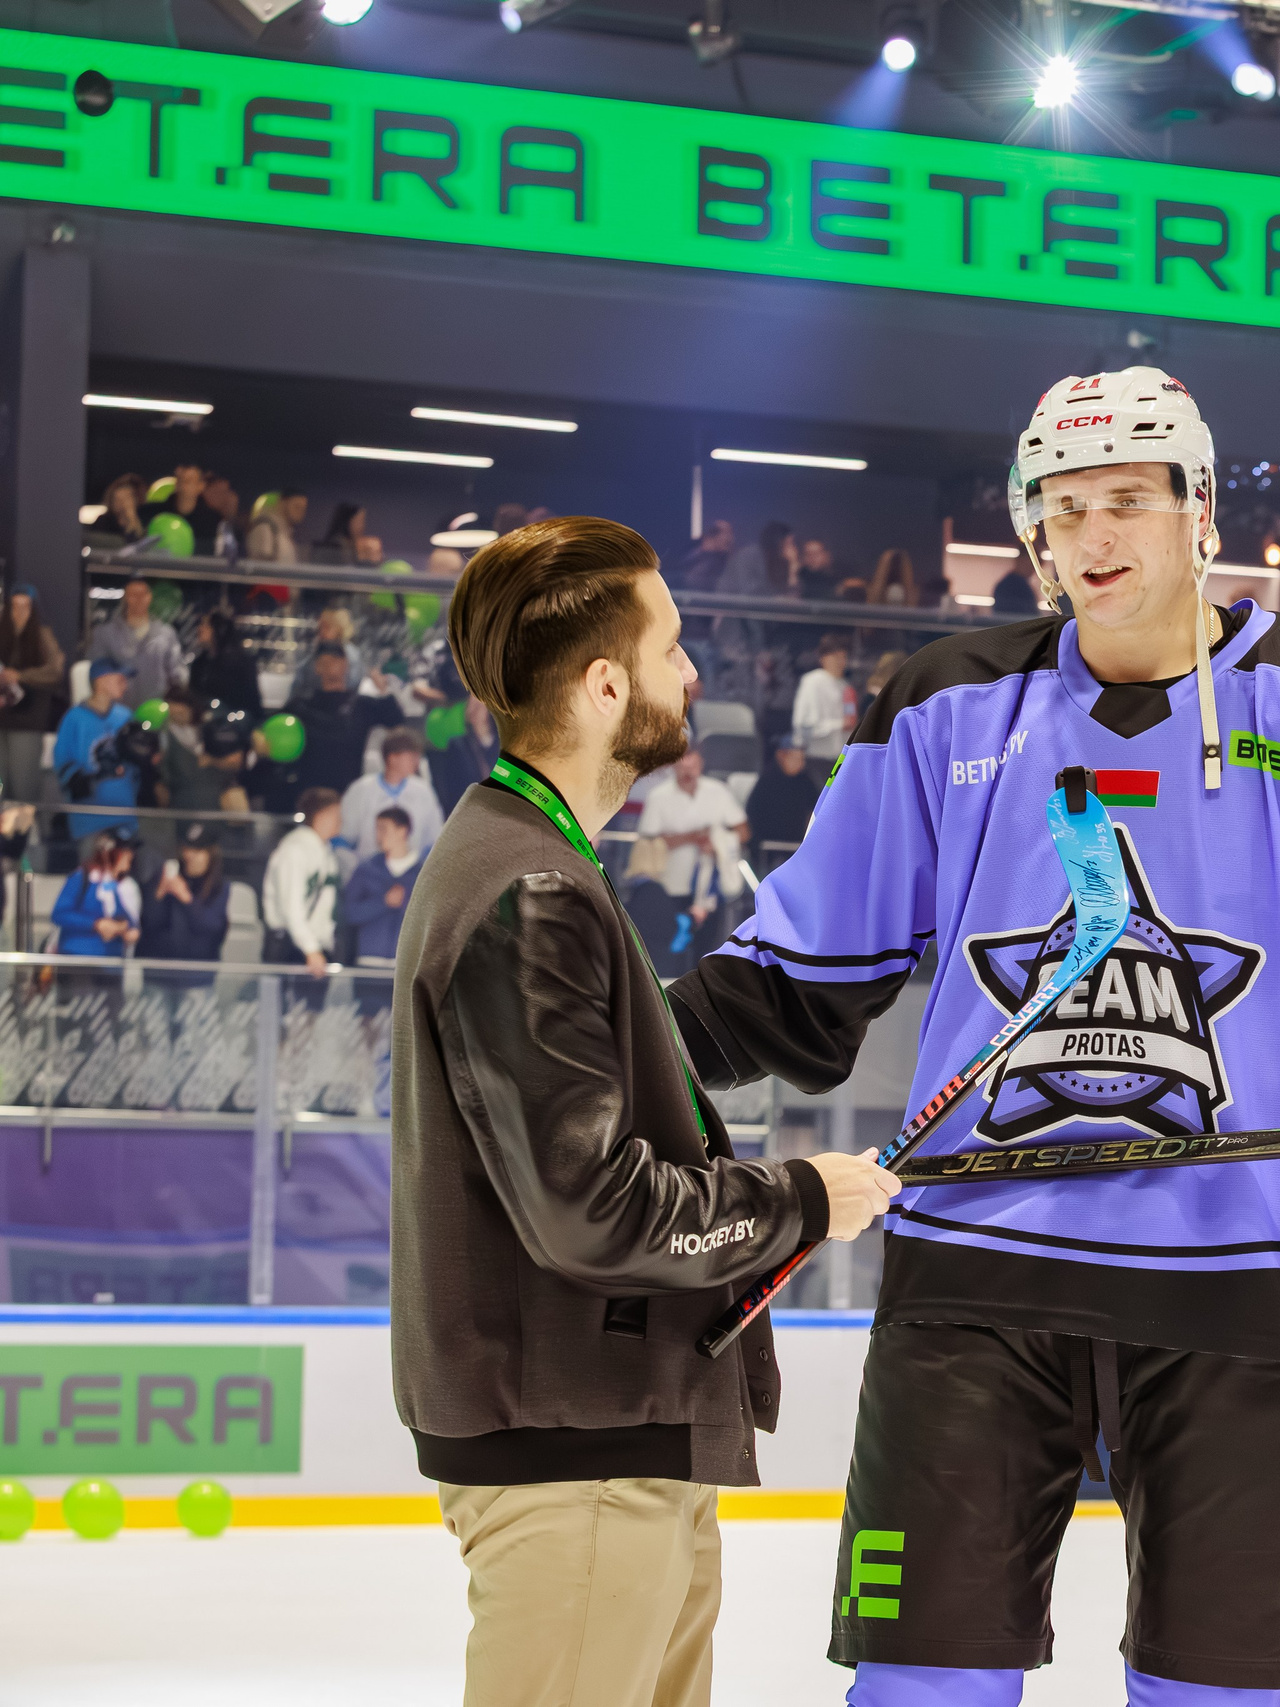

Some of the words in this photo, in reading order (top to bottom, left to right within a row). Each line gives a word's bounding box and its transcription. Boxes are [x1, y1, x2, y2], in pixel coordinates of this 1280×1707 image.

[1056, 414, 1113, 430] CCM
[990, 982, 1060, 1047] COVERT
[1061, 1033, 1147, 1058] PROTAS
[942, 1139, 1187, 1174] JETSPEED
[670, 1218, 755, 1255] HOCKEY.BY
